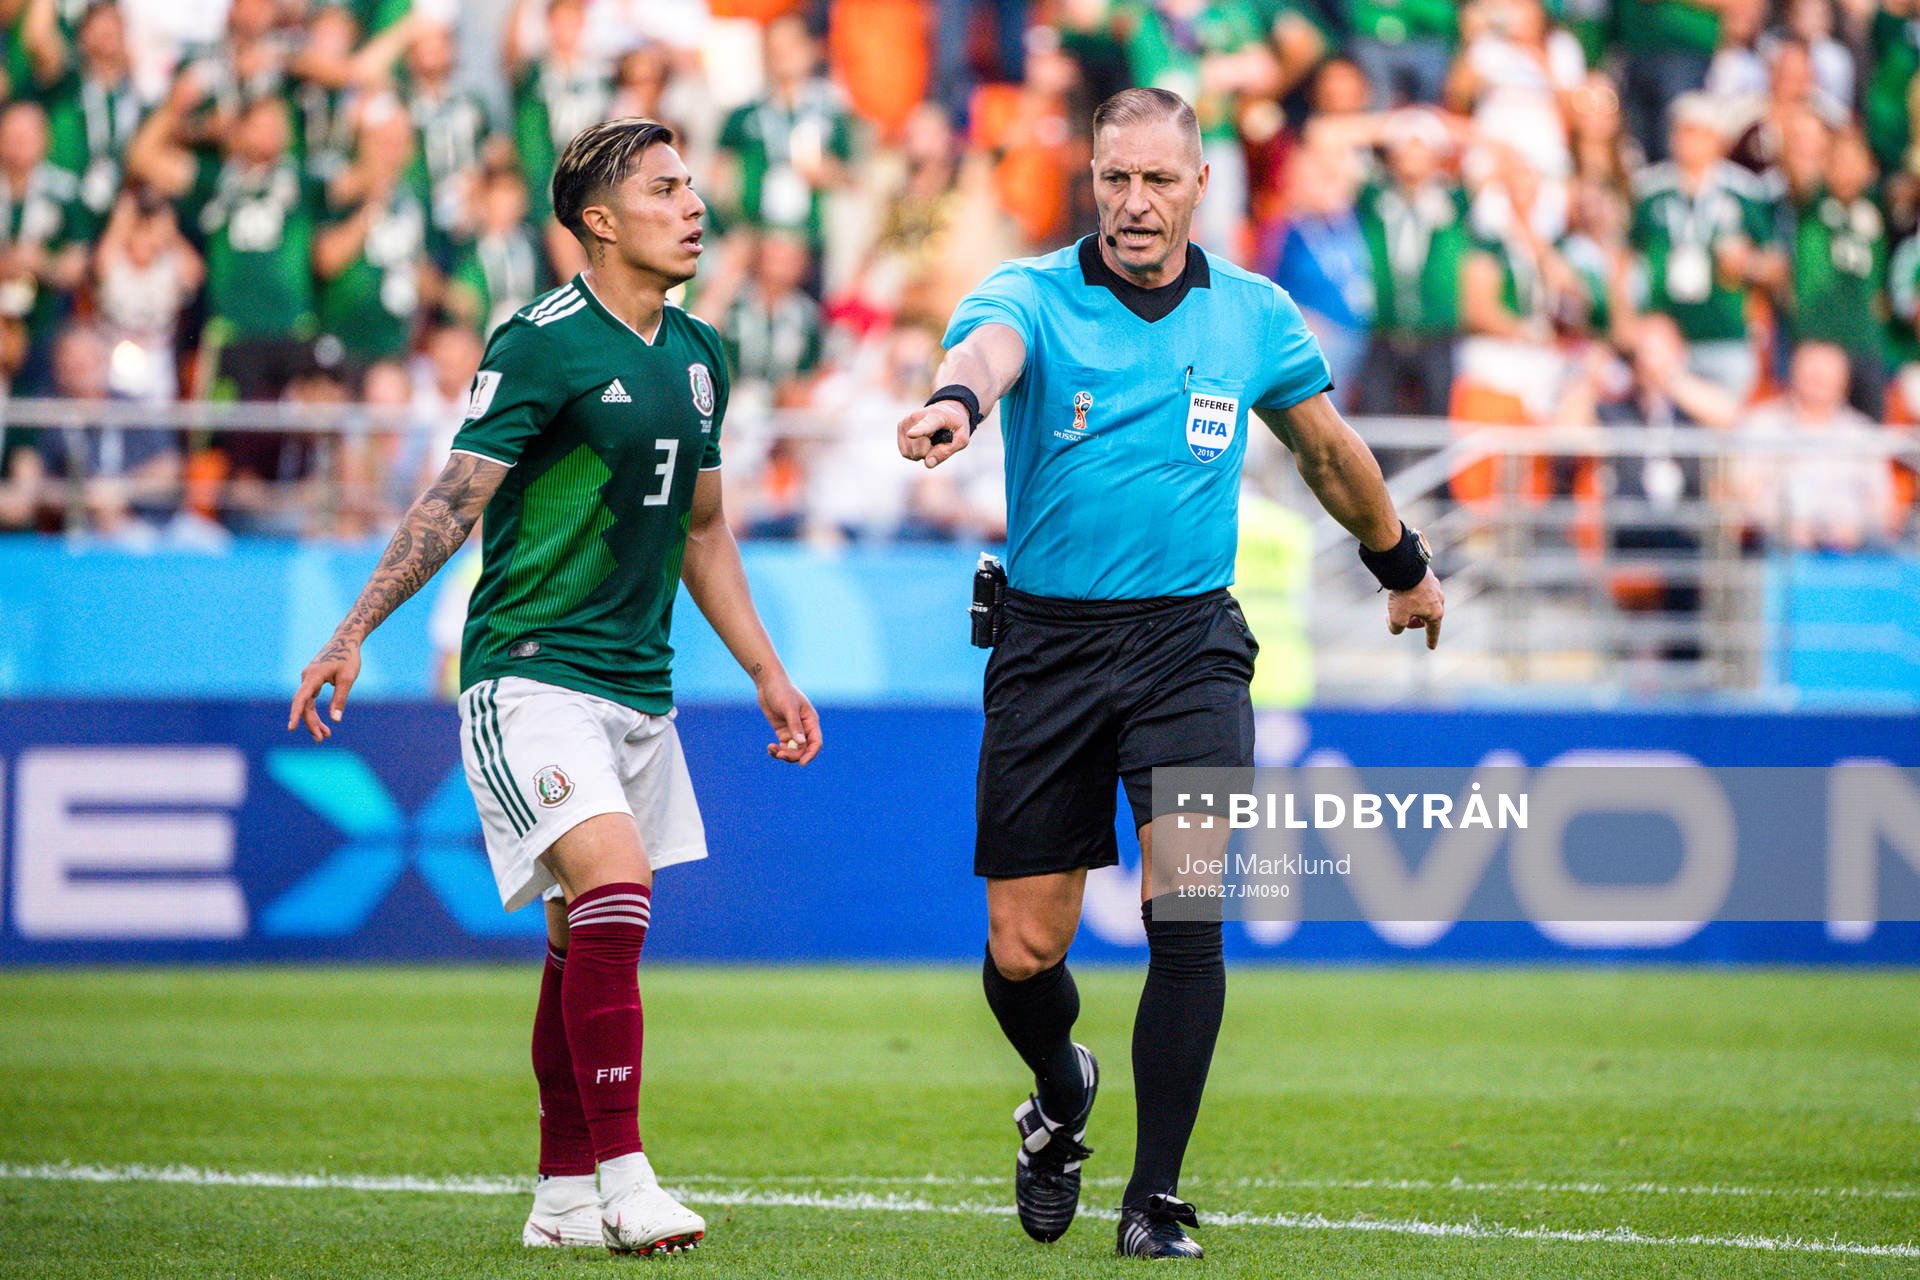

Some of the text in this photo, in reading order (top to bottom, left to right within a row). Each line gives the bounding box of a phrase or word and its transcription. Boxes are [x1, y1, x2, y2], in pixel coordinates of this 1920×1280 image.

[601, 392, 632, 403] adidas
[1193, 398, 1235, 413] REFEREE
[1053, 430, 1082, 442] RUSSIA
[1191, 418, 1227, 437] FIFA
[1196, 448, 1215, 458] 2018
[643, 438, 679, 506] 3
[1083, 709, 1738, 948] ivo
[0, 748, 548, 938] EX
[596, 1066, 633, 1084] FMF
